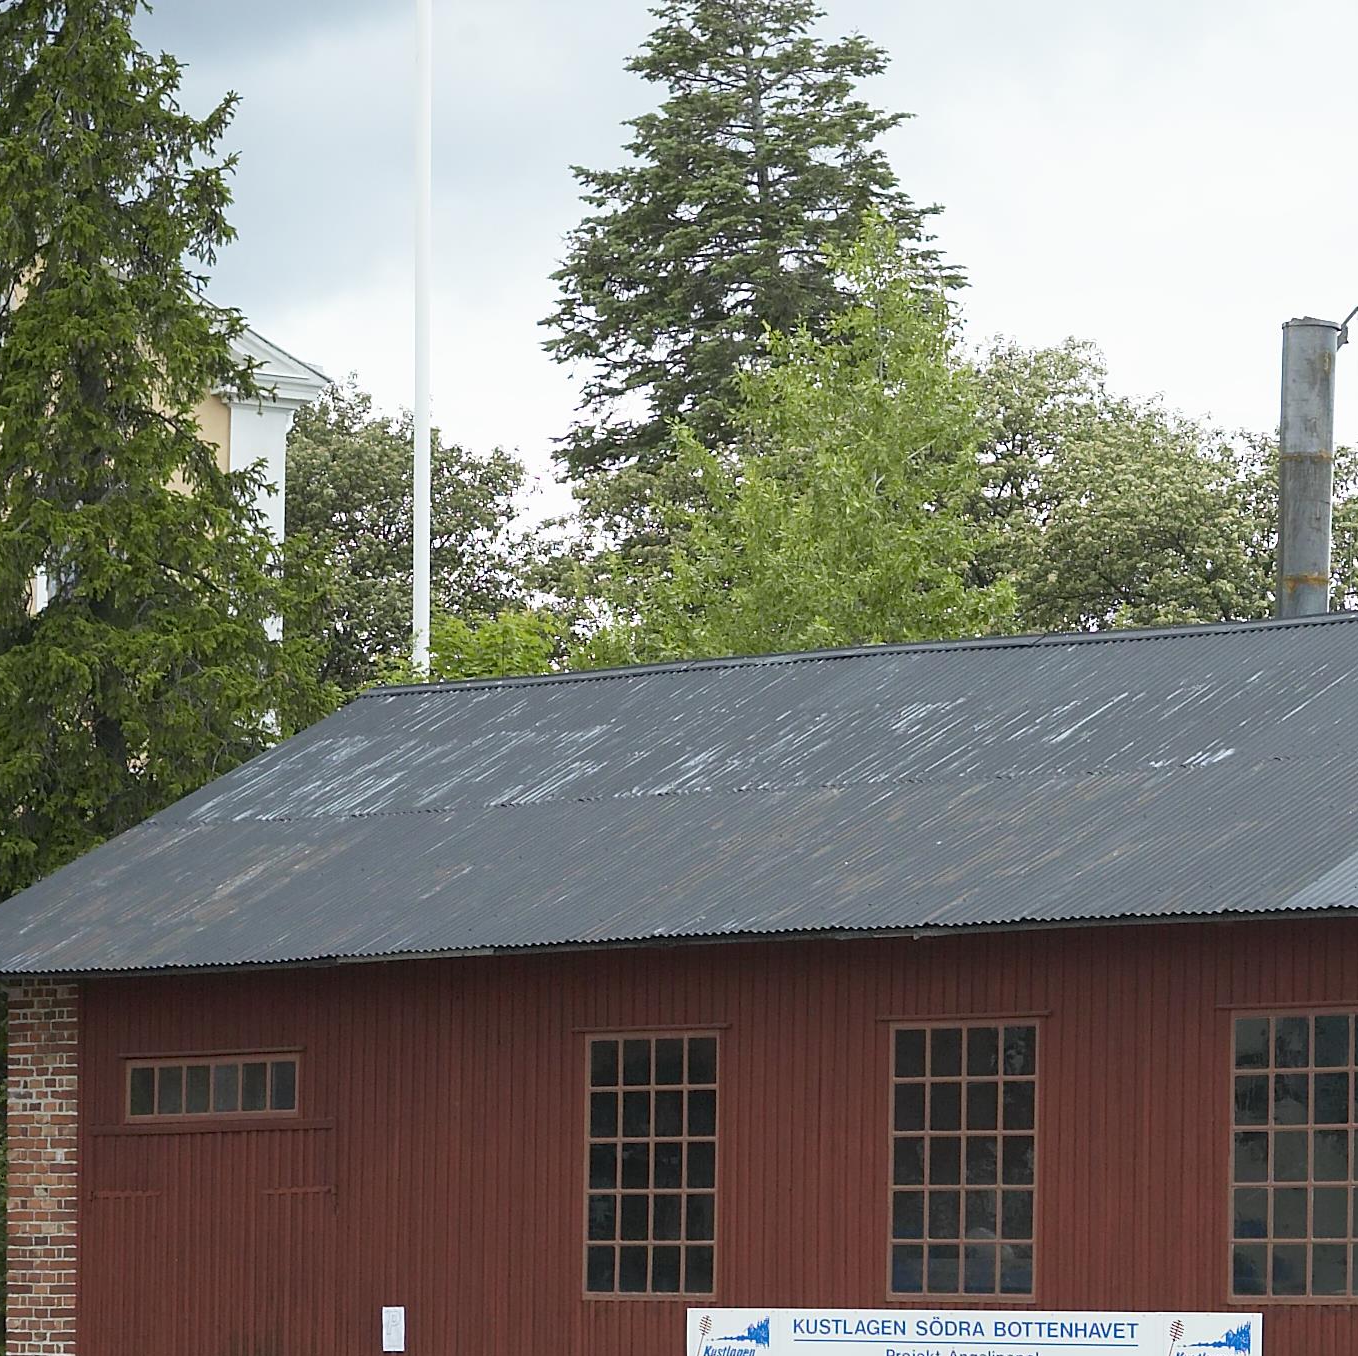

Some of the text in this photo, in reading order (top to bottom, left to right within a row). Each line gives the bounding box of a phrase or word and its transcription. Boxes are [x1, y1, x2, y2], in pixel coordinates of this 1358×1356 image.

[792, 1316, 1140, 1340] KUSTLAGEN SÖDRA BOTTENHAVET
